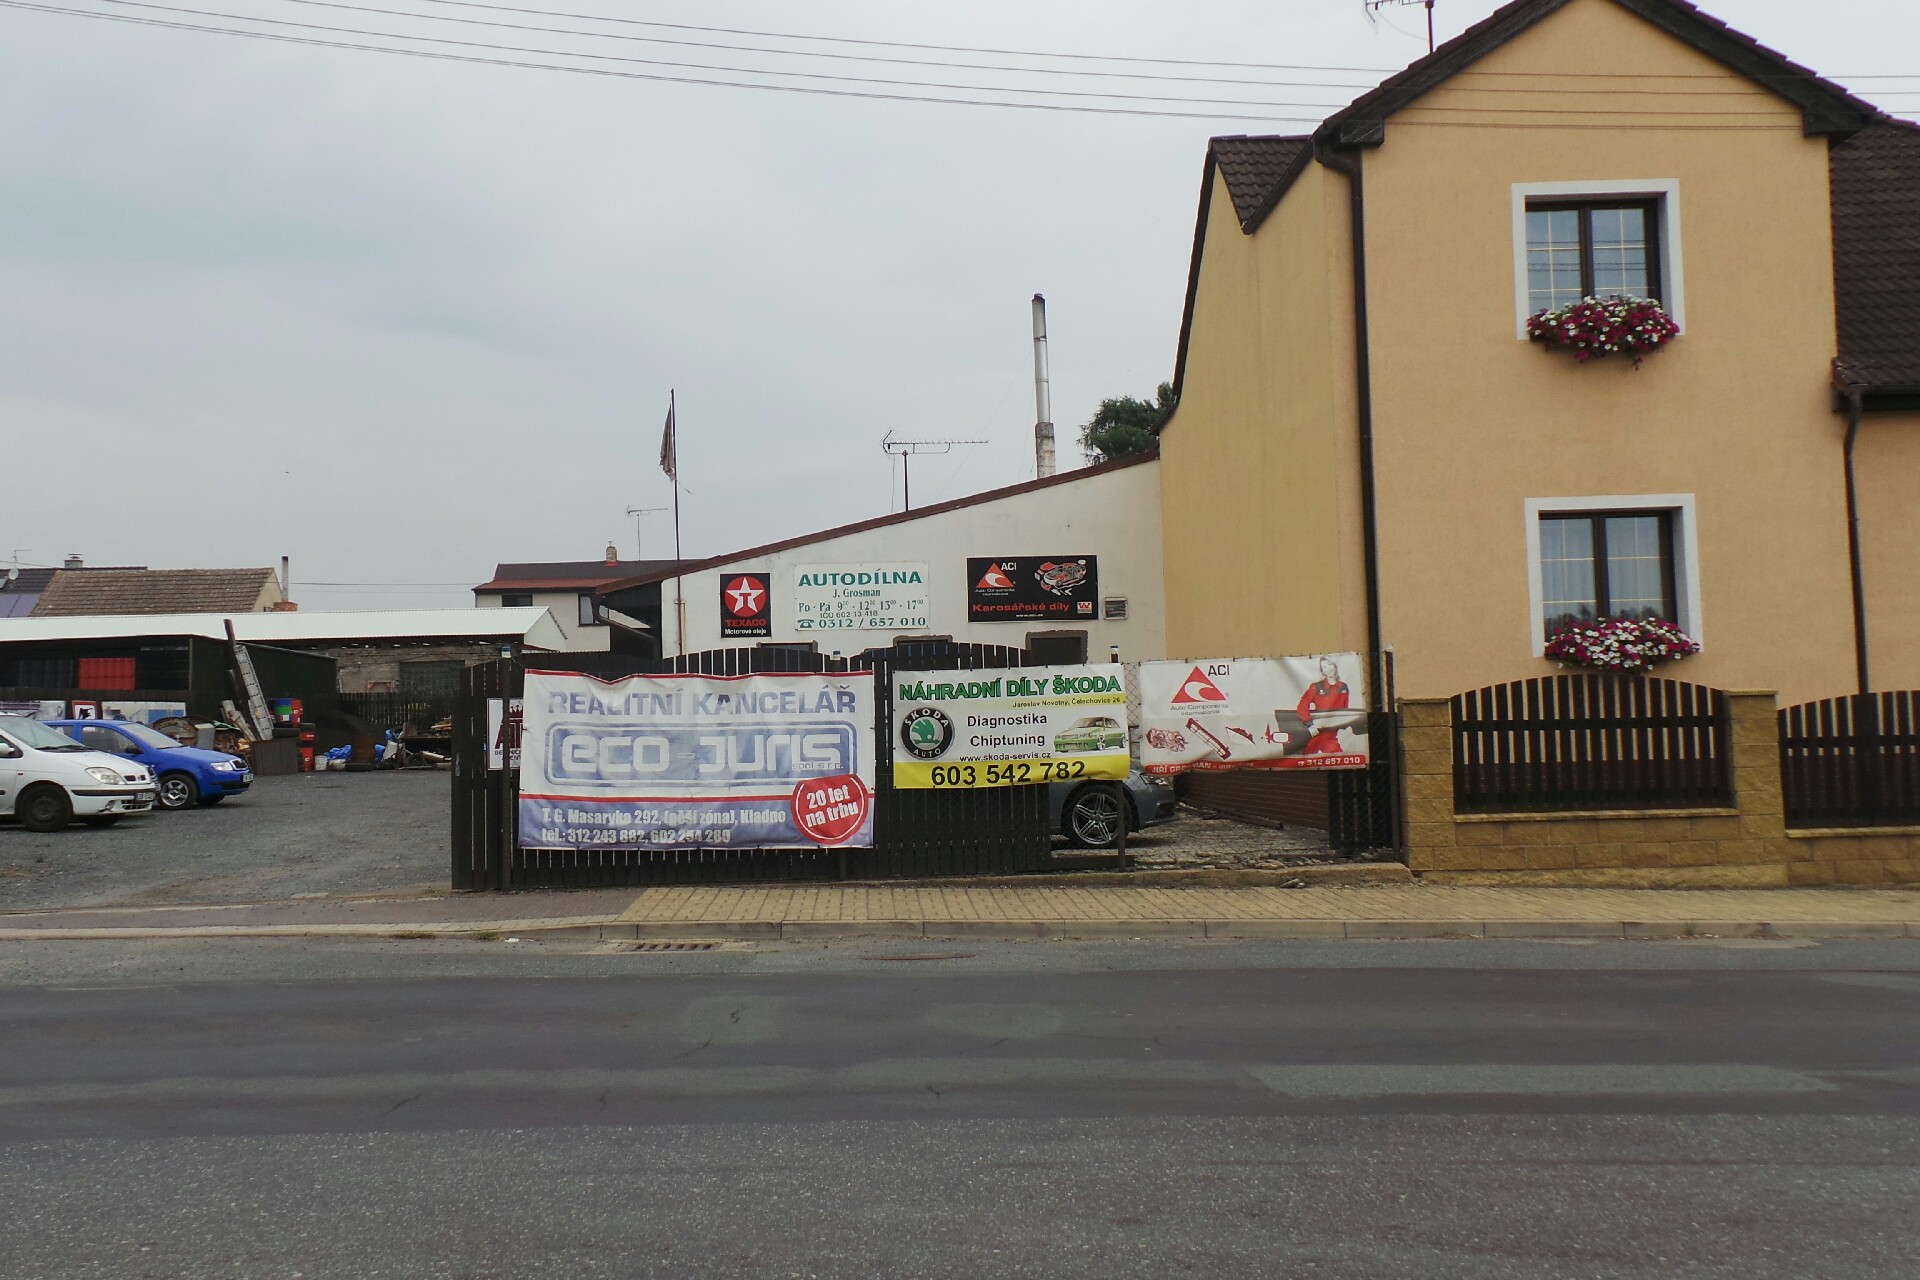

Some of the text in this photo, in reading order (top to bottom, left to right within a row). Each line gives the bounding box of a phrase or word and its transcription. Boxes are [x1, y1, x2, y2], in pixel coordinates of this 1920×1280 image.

[1001, 562, 1016, 570] ACI
[798, 568, 922, 587] AUTODÍLNA
[832, 588, 881, 598] J. Grosman
[798, 602, 810, 612] Po
[820, 601, 831, 612] Pá
[972, 602, 1070, 612] Karosářské díly
[725, 618, 766, 627] TEXACO
[818, 619, 853, 628] 0312
[869, 618, 894, 627] 657
[900, 617, 926, 626] 010
[1208, 664, 1230, 676] ACI
[900, 674, 1122, 701] NÁHRADNÍ DÍLY ŠKODA
[549, 684, 856, 716] REALITNÍ KANCELÁŘ
[967, 713, 1048, 729] Diagnostika
[970, 734, 1045, 748] Chiptuning
[913, 748, 940, 757] AUTO
[959, 752, 1051, 762] www.skoda-servis.cz
[1325, 757, 1342, 765] 657
[1344, 756, 1360, 764] 010
[931, 760, 1085, 786] 603 542 782
[1152, 764, 1168, 774] JIŘÍ
[806, 784, 850, 809] 20 let
[543, 808, 551, 822] T.
[554, 808, 565, 822] G.
[568, 808, 632, 826] Masaryka
[634, 810, 661, 825] 292,
[740, 809, 786, 823] Kladno
[806, 801, 859, 828] na trhu
[542, 828, 566, 841] tel.:
[568, 829, 590, 842] 312
[593, 830, 617, 843] 243
[650, 829, 675, 844] 602
